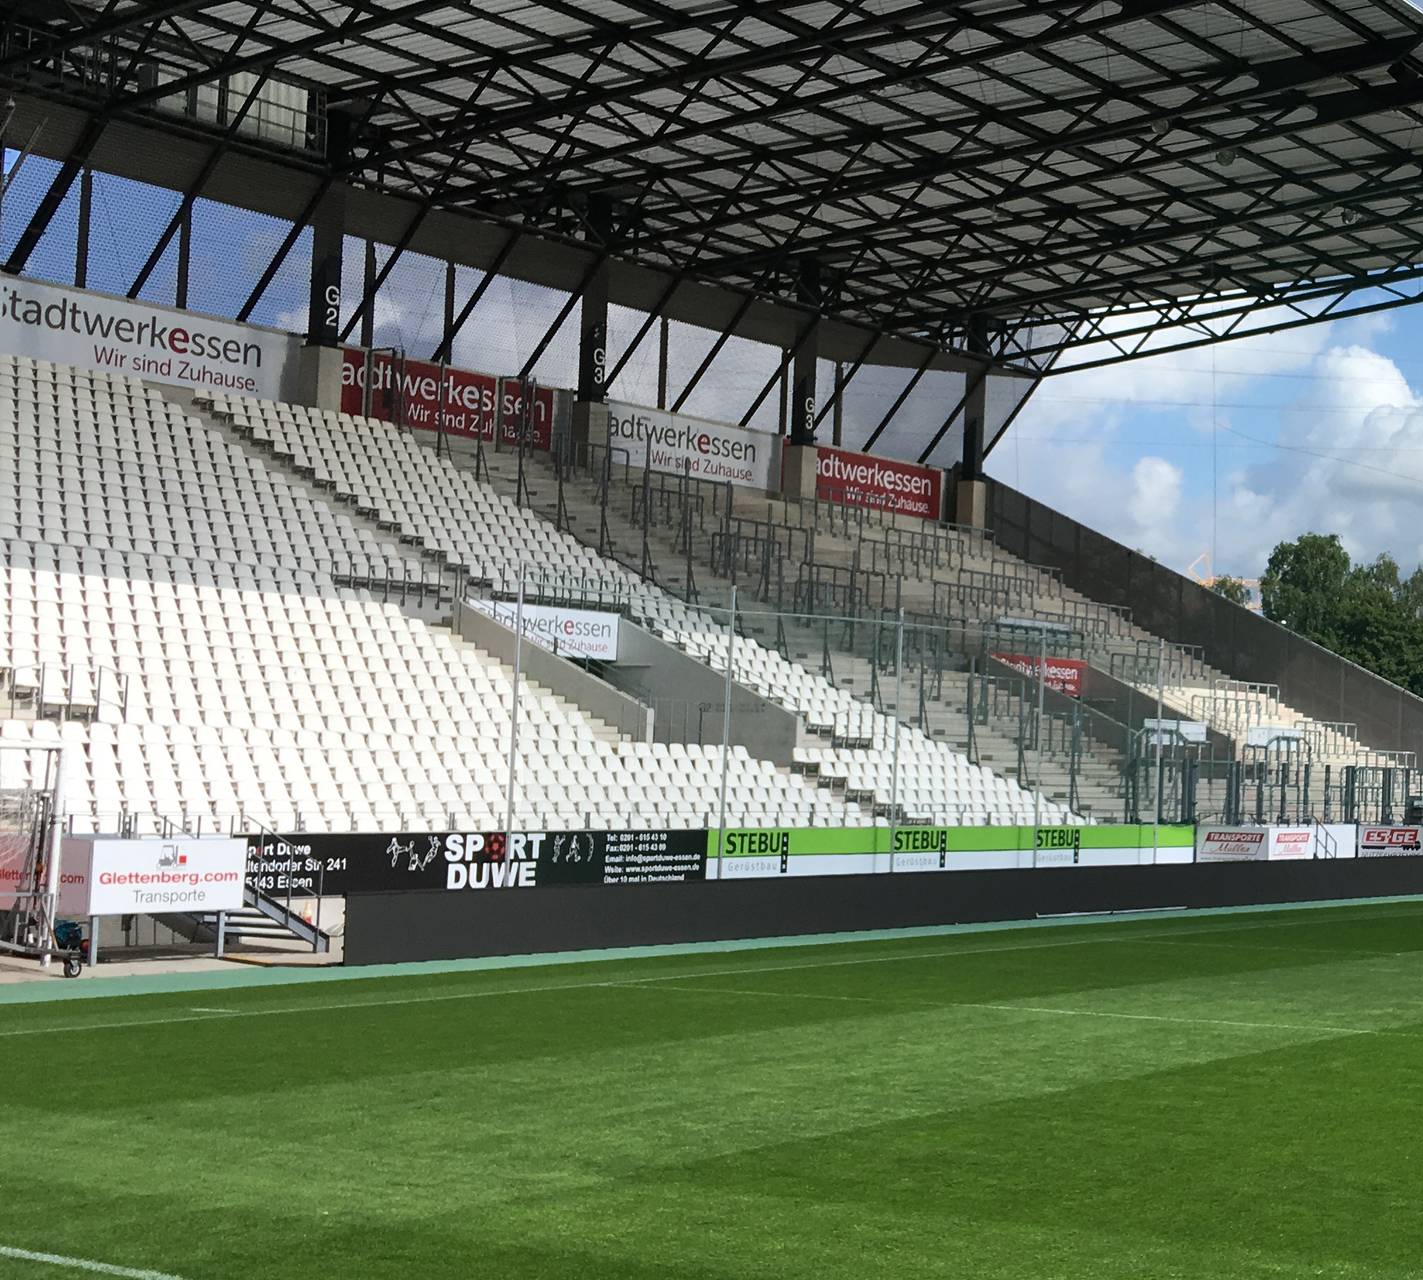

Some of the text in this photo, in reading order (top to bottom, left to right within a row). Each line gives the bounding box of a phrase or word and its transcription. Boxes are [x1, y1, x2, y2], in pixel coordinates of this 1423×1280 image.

[2, 286, 262, 367] tadtwerkessen
[94, 345, 259, 393] Wir sind Zuhause.
[652, 450, 673, 467] Wir
[703, 459, 754, 482] Zuhause.
[725, 832, 782, 854] STEBU
[894, 831, 940, 851] STEBU
[1036, 829, 1074, 847] STEBU
[1209, 832, 1261, 842] TRANSPORTE
[245, 859, 302, 872] ltendorfer
[326, 858, 347, 871] 241
[728, 861, 778, 872] Gerüstbau
[99, 870, 239, 885] Glettenberg.com
[447, 861, 537, 889] DUWE
[133, 889, 206, 904] Transporte
